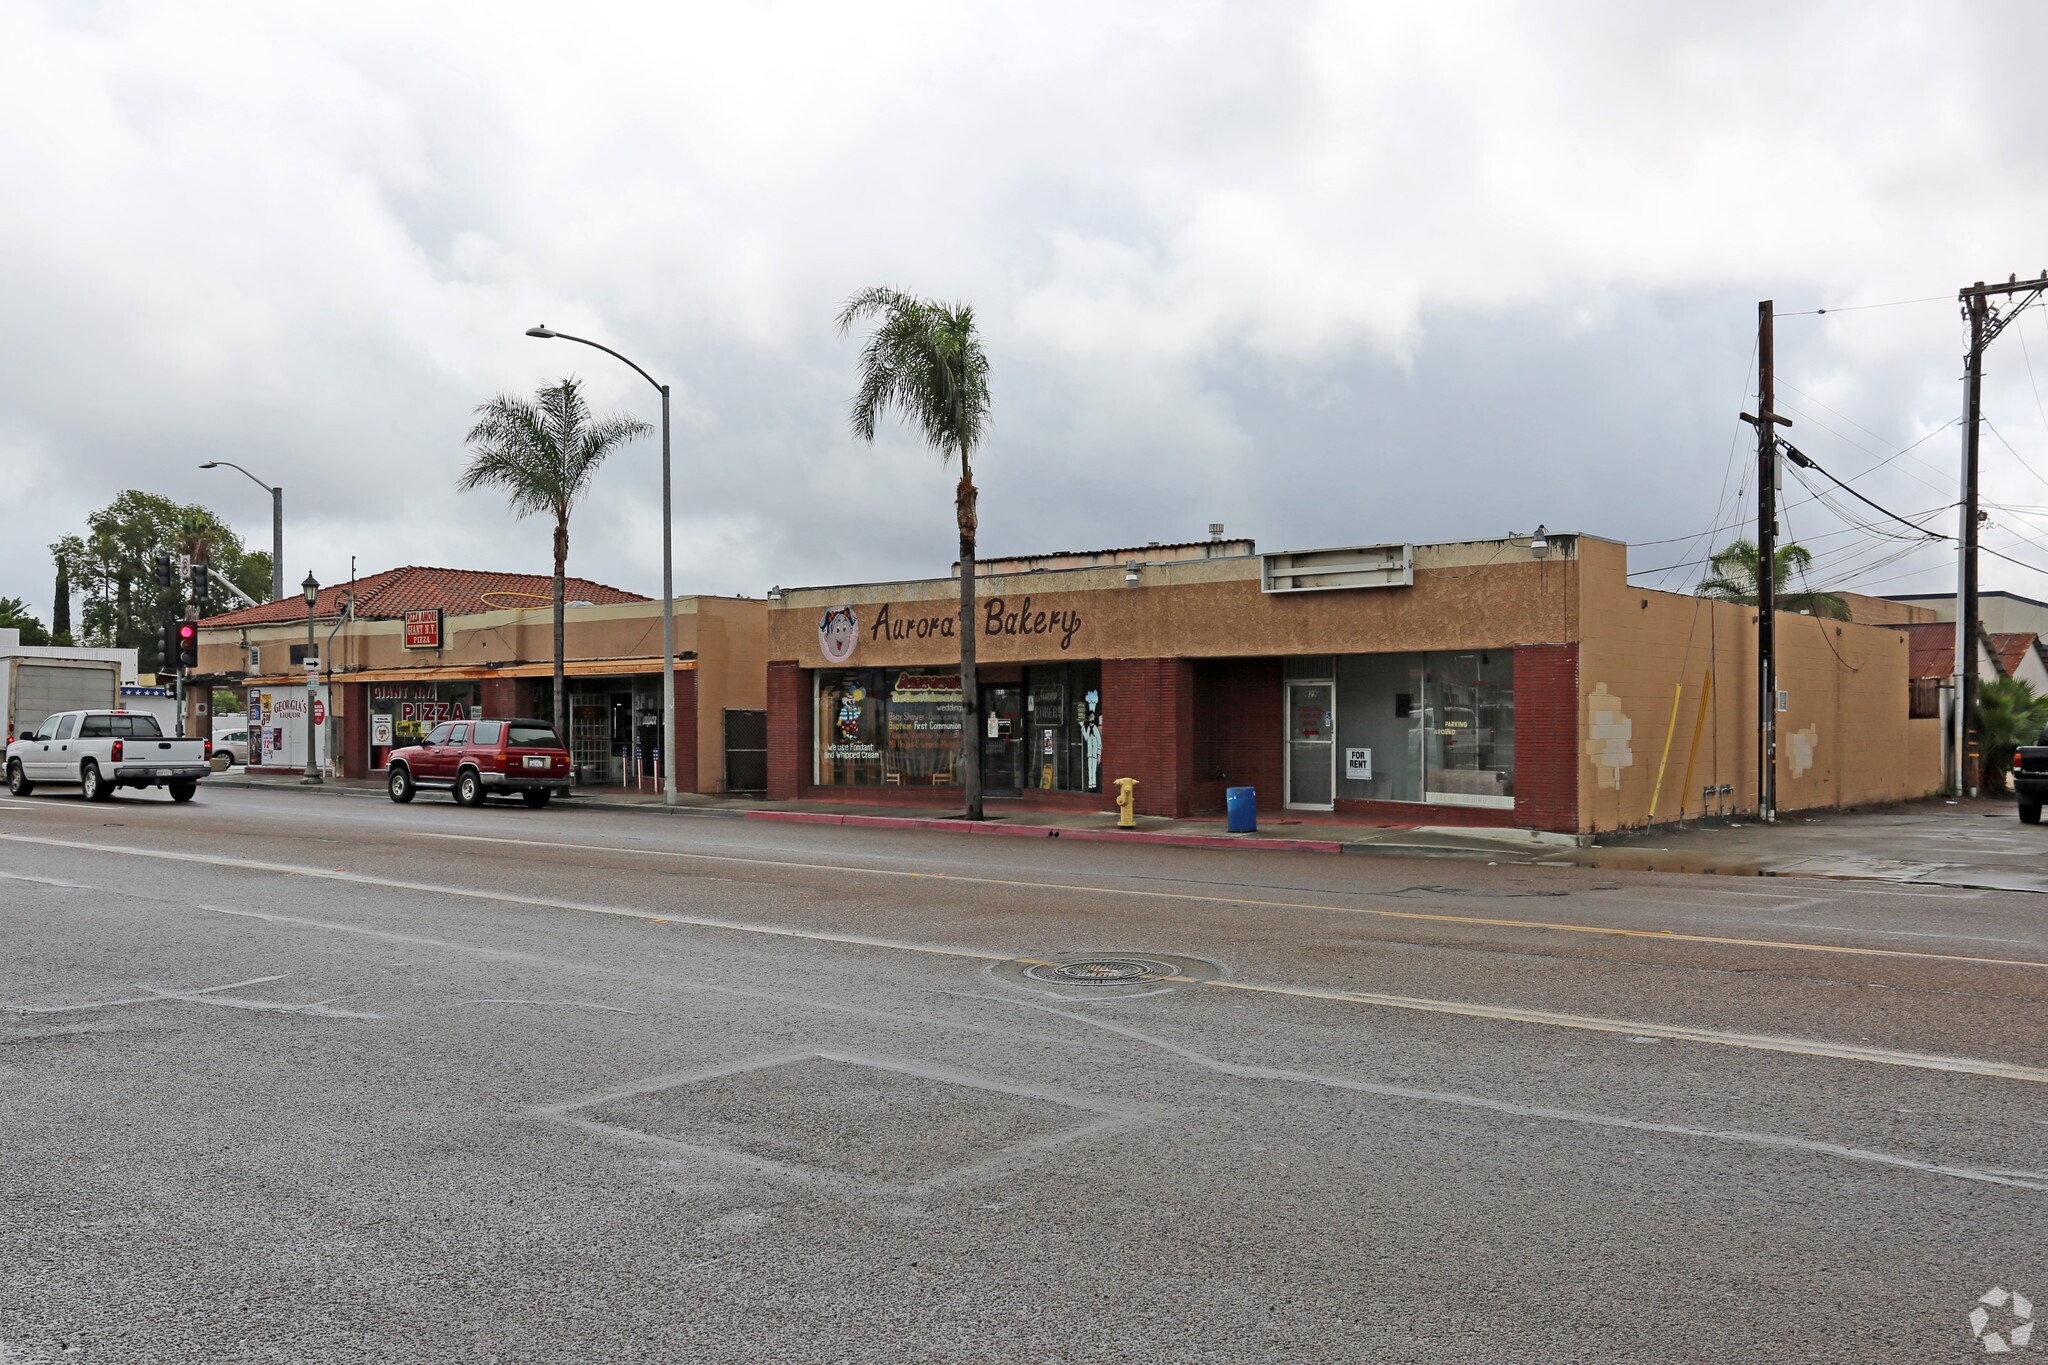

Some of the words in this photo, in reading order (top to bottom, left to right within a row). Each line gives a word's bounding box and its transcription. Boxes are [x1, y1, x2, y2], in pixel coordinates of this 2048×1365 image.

[407, 612, 419, 623] PIZZA
[421, 611, 437, 622] AMORE
[983, 596, 1082, 650] Bakery
[407, 624, 424, 635] GIANT
[425, 624, 437, 635] N.Y.
[413, 636, 430, 644] PIZZA
[374, 685, 408, 699] GIANT
[274, 699, 307, 714] GEORGIA'S
[401, 702, 466, 721] PIZZA
[888, 712, 903, 721] Baby
[903, 712, 925, 720] Shower
[913, 721, 928, 729] First
[929, 721, 962, 730] Communion
[827, 743, 837, 751] We
[849, 743, 873, 751] Fondant
[835, 751, 860, 760] Whipped
[1351, 751, 1365, 759] FOR
[1349, 760, 1367, 768] RENT
